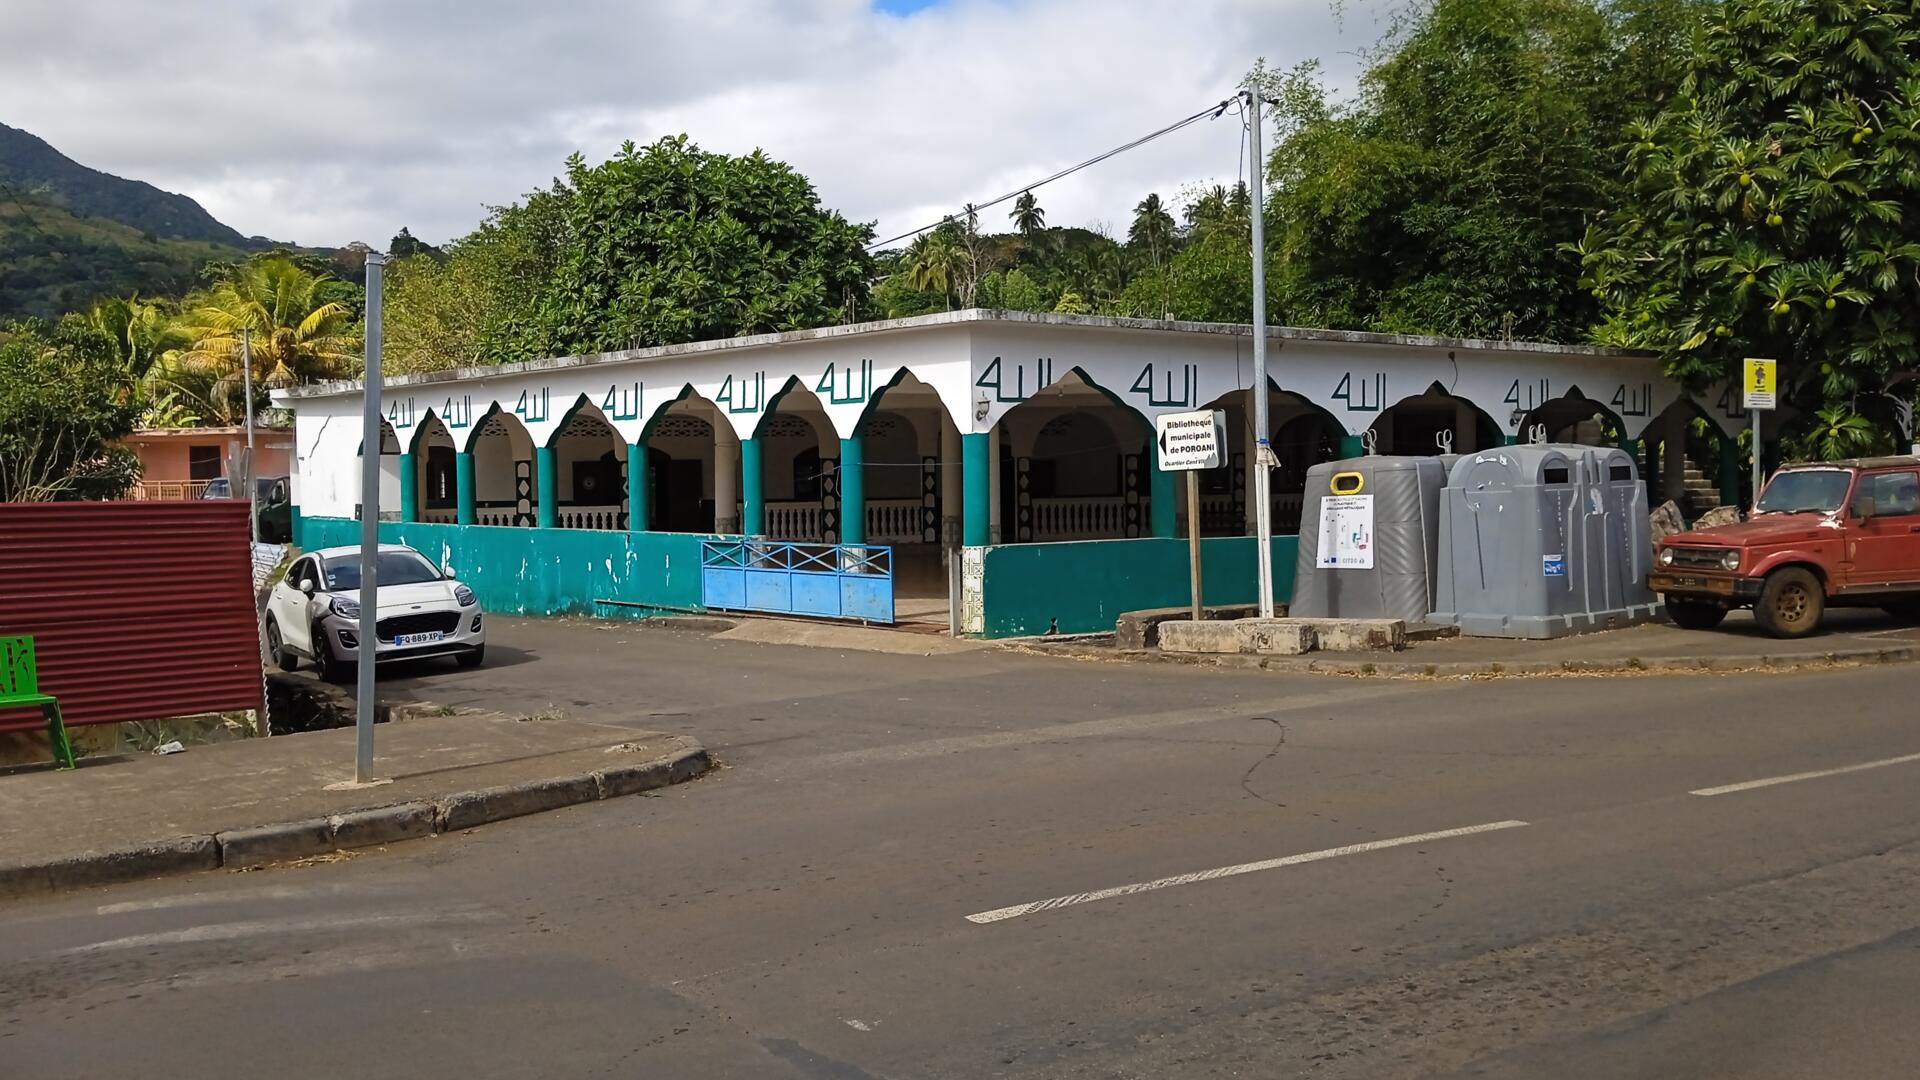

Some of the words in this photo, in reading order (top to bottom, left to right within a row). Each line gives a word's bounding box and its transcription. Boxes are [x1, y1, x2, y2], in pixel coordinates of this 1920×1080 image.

[716, 371, 765, 413] الله
[816, 359, 872, 404] الله
[1130, 363, 1197, 408] الله
[1331, 372, 1386, 411] الله
[515, 386, 549, 423] الله
[602, 382, 643, 420] الله
[1170, 432, 1211, 441] municipale
[1170, 446, 1180, 454] de
[1180, 443, 1214, 453] POROANI
